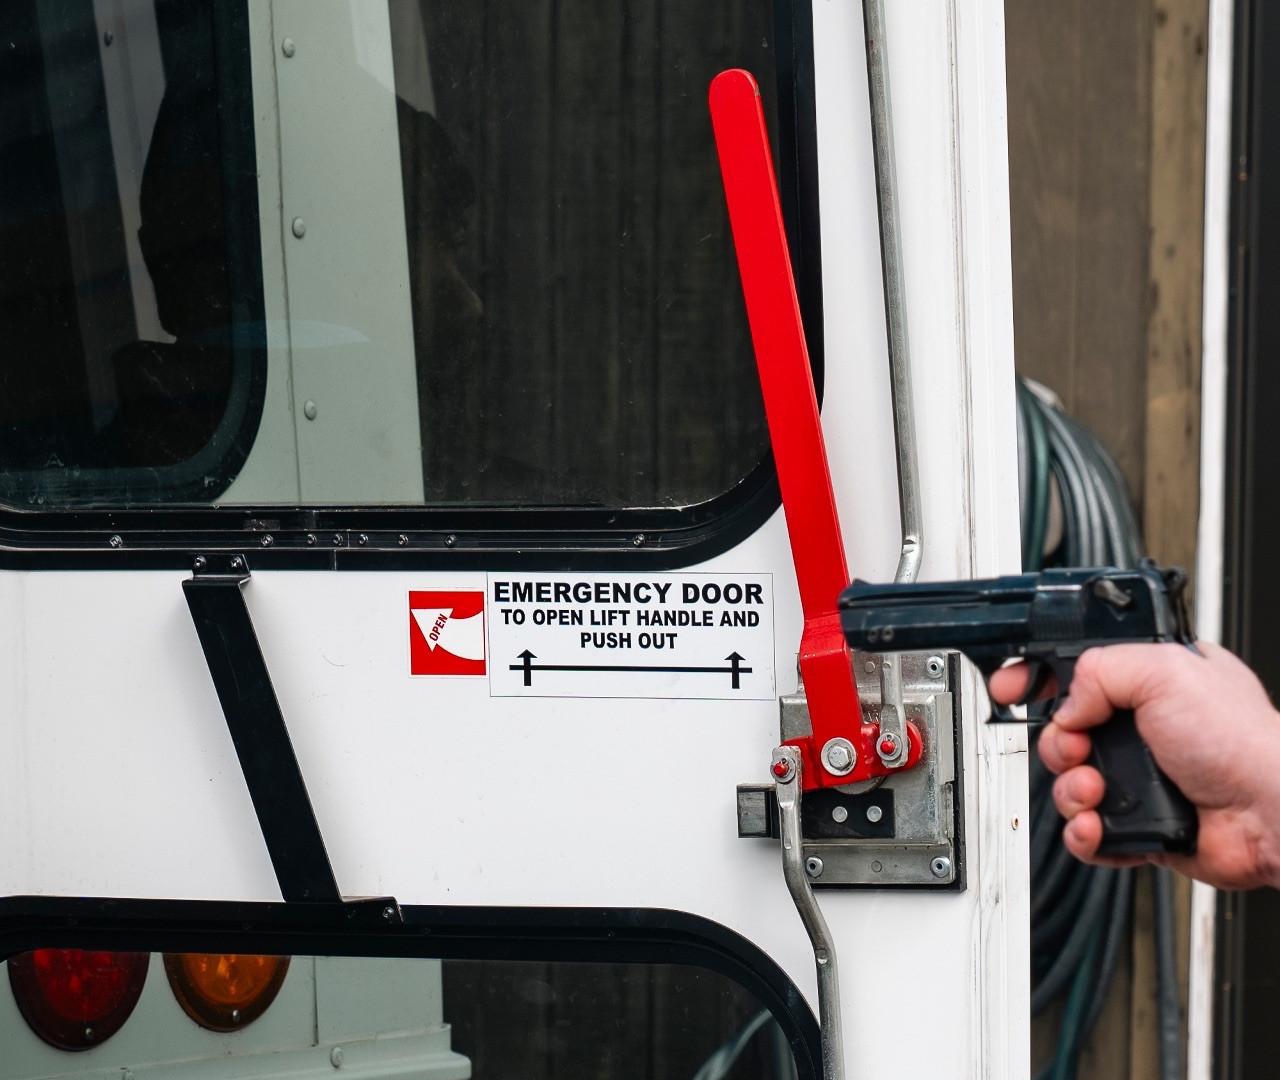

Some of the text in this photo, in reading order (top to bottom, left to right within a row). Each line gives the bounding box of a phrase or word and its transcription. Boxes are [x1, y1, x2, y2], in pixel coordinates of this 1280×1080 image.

[494, 582, 763, 604] EMERGENCY DOOR
[429, 613, 448, 641] OPEN
[501, 609, 760, 627] TO OPEN LIFT HANDLE AND
[580, 632, 677, 649] PUSH OUT
